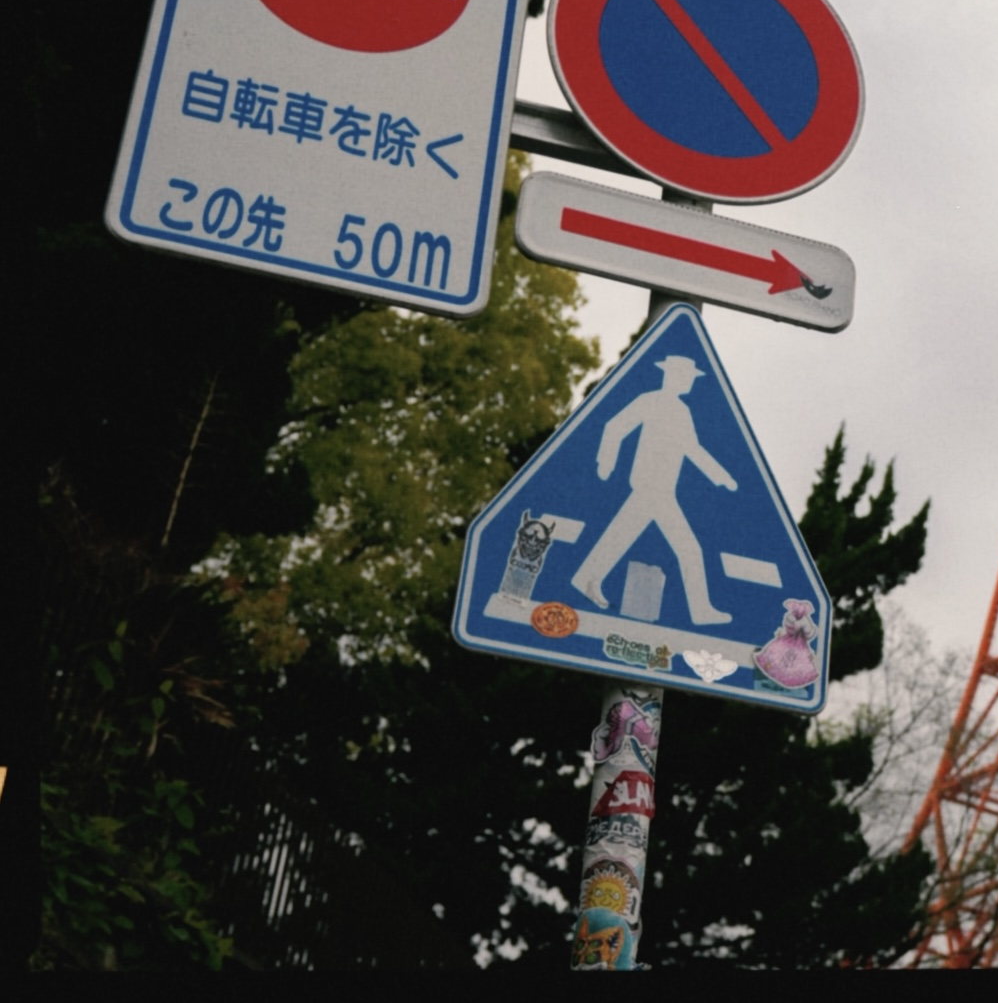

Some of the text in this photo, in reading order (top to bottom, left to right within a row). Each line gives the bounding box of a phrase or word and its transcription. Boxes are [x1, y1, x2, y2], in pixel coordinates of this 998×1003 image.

[182, 70, 464, 179] 自転車を除く
[159, 178, 452, 290] この先 50m
